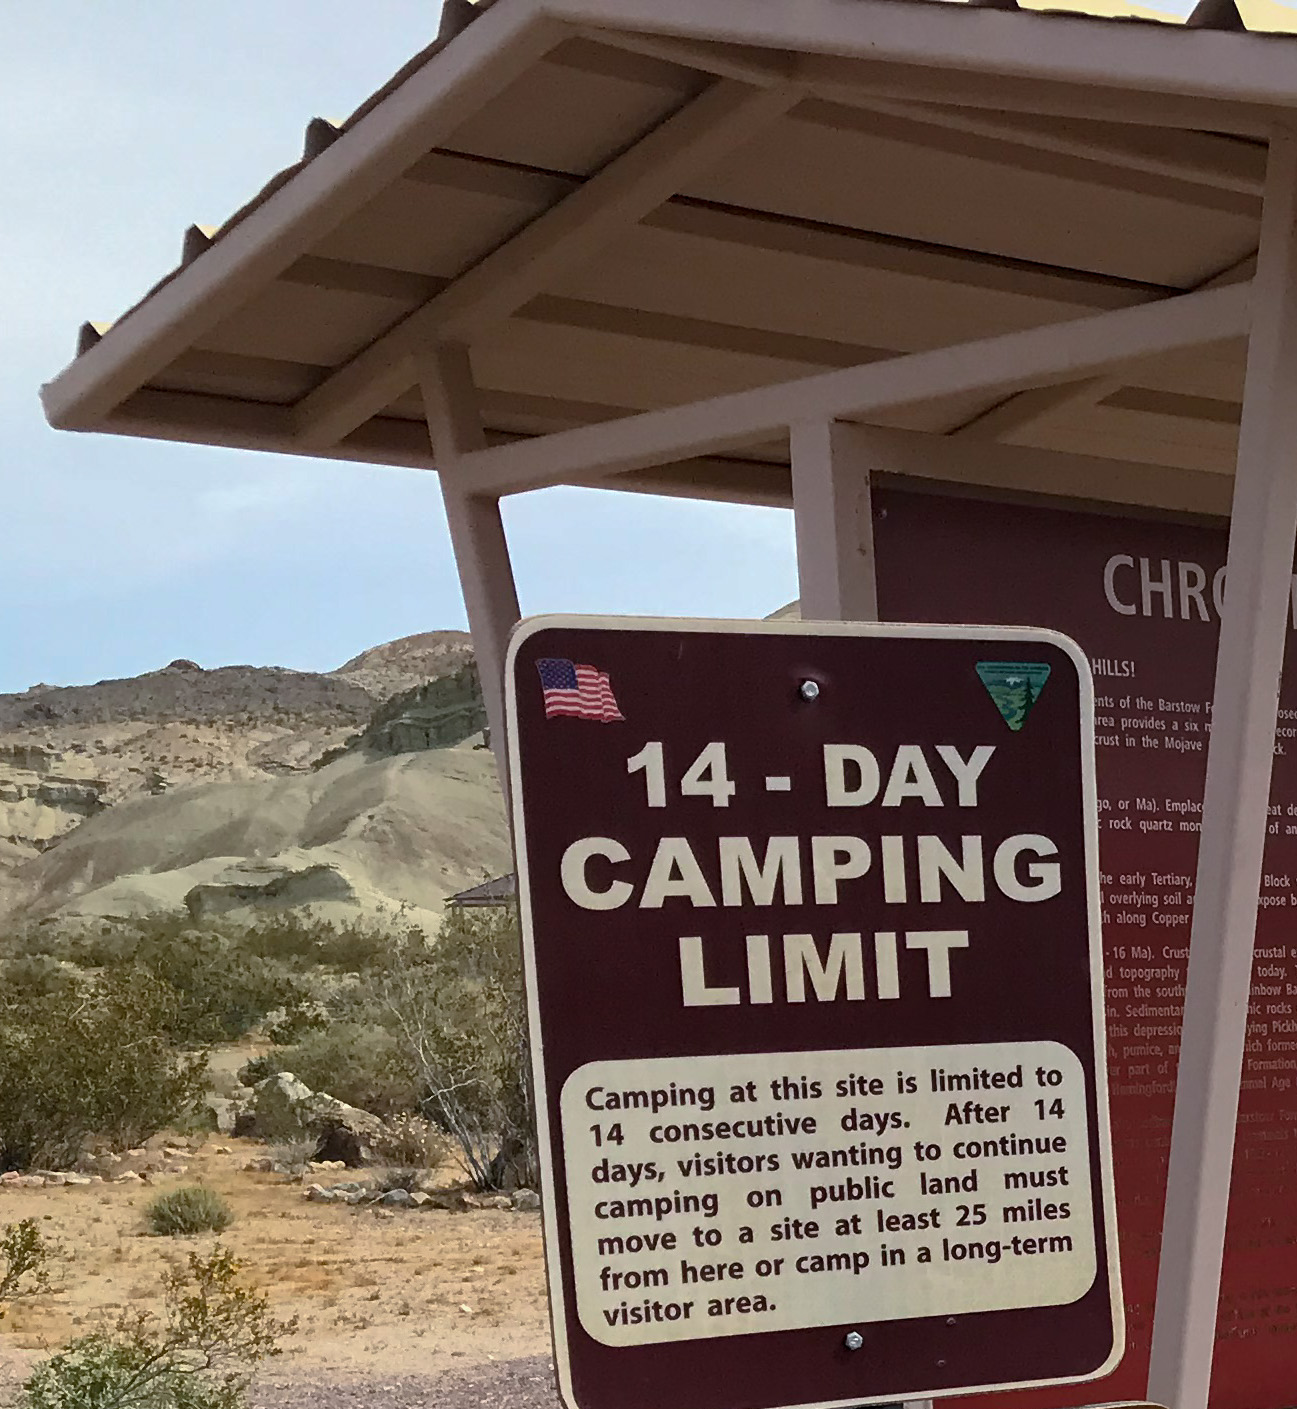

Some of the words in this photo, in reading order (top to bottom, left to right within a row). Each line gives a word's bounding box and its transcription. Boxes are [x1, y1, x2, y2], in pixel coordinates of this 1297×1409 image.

[1092, 658, 1136, 678] HILLS!
[628, 742, 735, 807] 14
[824, 744, 996, 806] DAY
[561, 834, 1061, 910] CAMPING
[679, 930, 969, 1006] LIMIT
[586, 1082, 715, 1113] Camping
[730, 1081, 757, 1102] at
[770, 1076, 822, 1100] this
[836, 1074, 883, 1097] site
[897, 1071, 917, 1094] is
[931, 1065, 1022, 1092] limited
[1036, 1067, 1062, 1086] to
[590, 1123, 624, 1146] 14
[650, 1112, 816, 1143] consecutive
[841, 1108, 910, 1136] days.
[945, 1101, 1010, 1125] After
[1035, 1098, 1064, 1120] 14
[592, 1158, 664, 1187] days,
[677, 1151, 779, 1177] visitors
[791, 1142, 902, 1169] wanting
[914, 1141, 941, 1161] to
[953, 1133, 1066, 1158] continue
[595, 1190, 718, 1221] camping
[747, 1189, 782, 1207] on
[810, 1176, 894, 1209] public
[921, 1169, 977, 1195] land
[1004, 1166, 1068, 1189] must
[598, 1233, 676, 1255] move
[692, 1227, 722, 1247] to
[739, 1226, 753, 1243] a
[771, 1217, 819, 1241] site
[836, 1214, 862, 1236] at
[878, 1208, 940, 1232] least
[956, 1204, 986, 1226] 25
[1003, 1198, 1070, 1222] miles
[600, 1266, 668, 1290] from
[681, 1260, 743, 1283] here
[756, 1258, 784, 1276] or
[796, 1252, 869, 1274] camp
[881, 1244, 905, 1266] in
[917, 1247, 931, 1263] a
[943, 1236, 1072, 1263] long-term
[603, 1300, 694, 1326] visitor
[708, 1295, 776, 1316] area.
